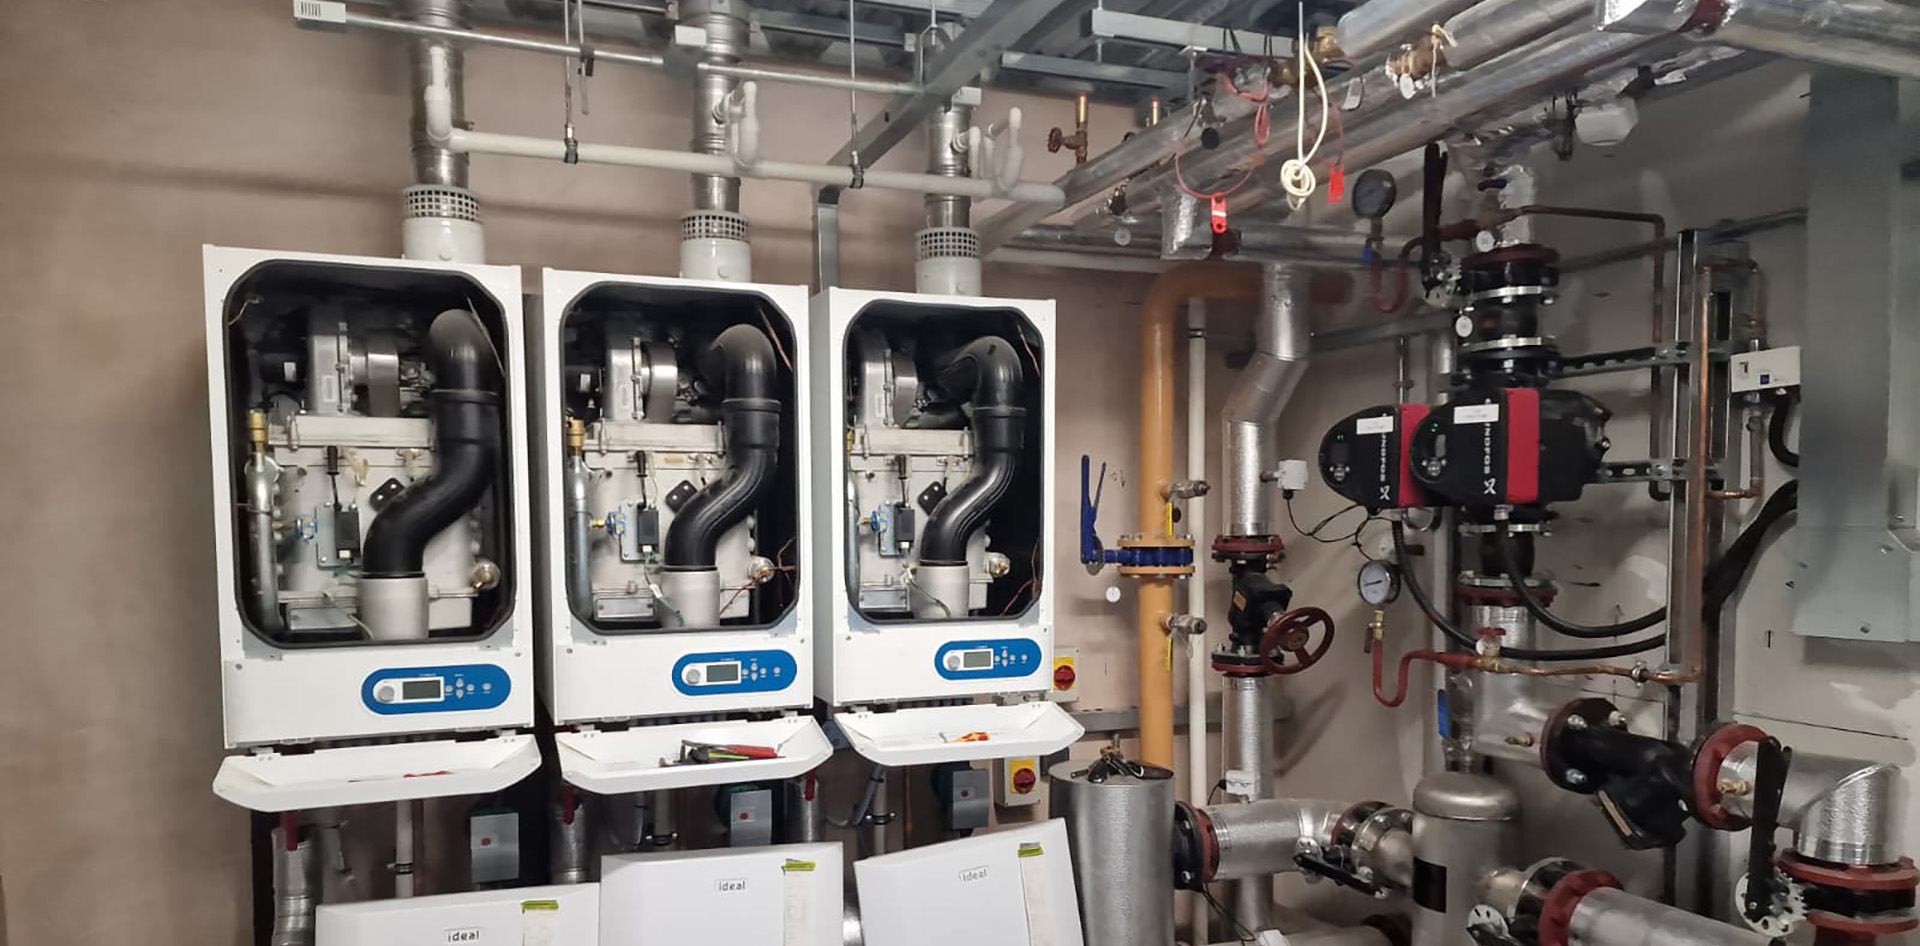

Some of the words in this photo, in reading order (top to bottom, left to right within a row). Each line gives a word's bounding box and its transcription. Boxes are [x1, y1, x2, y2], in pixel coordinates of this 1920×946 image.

[963, 868, 988, 882] ideal
[718, 880, 746, 892] ideal
[447, 929, 480, 943] ideal
